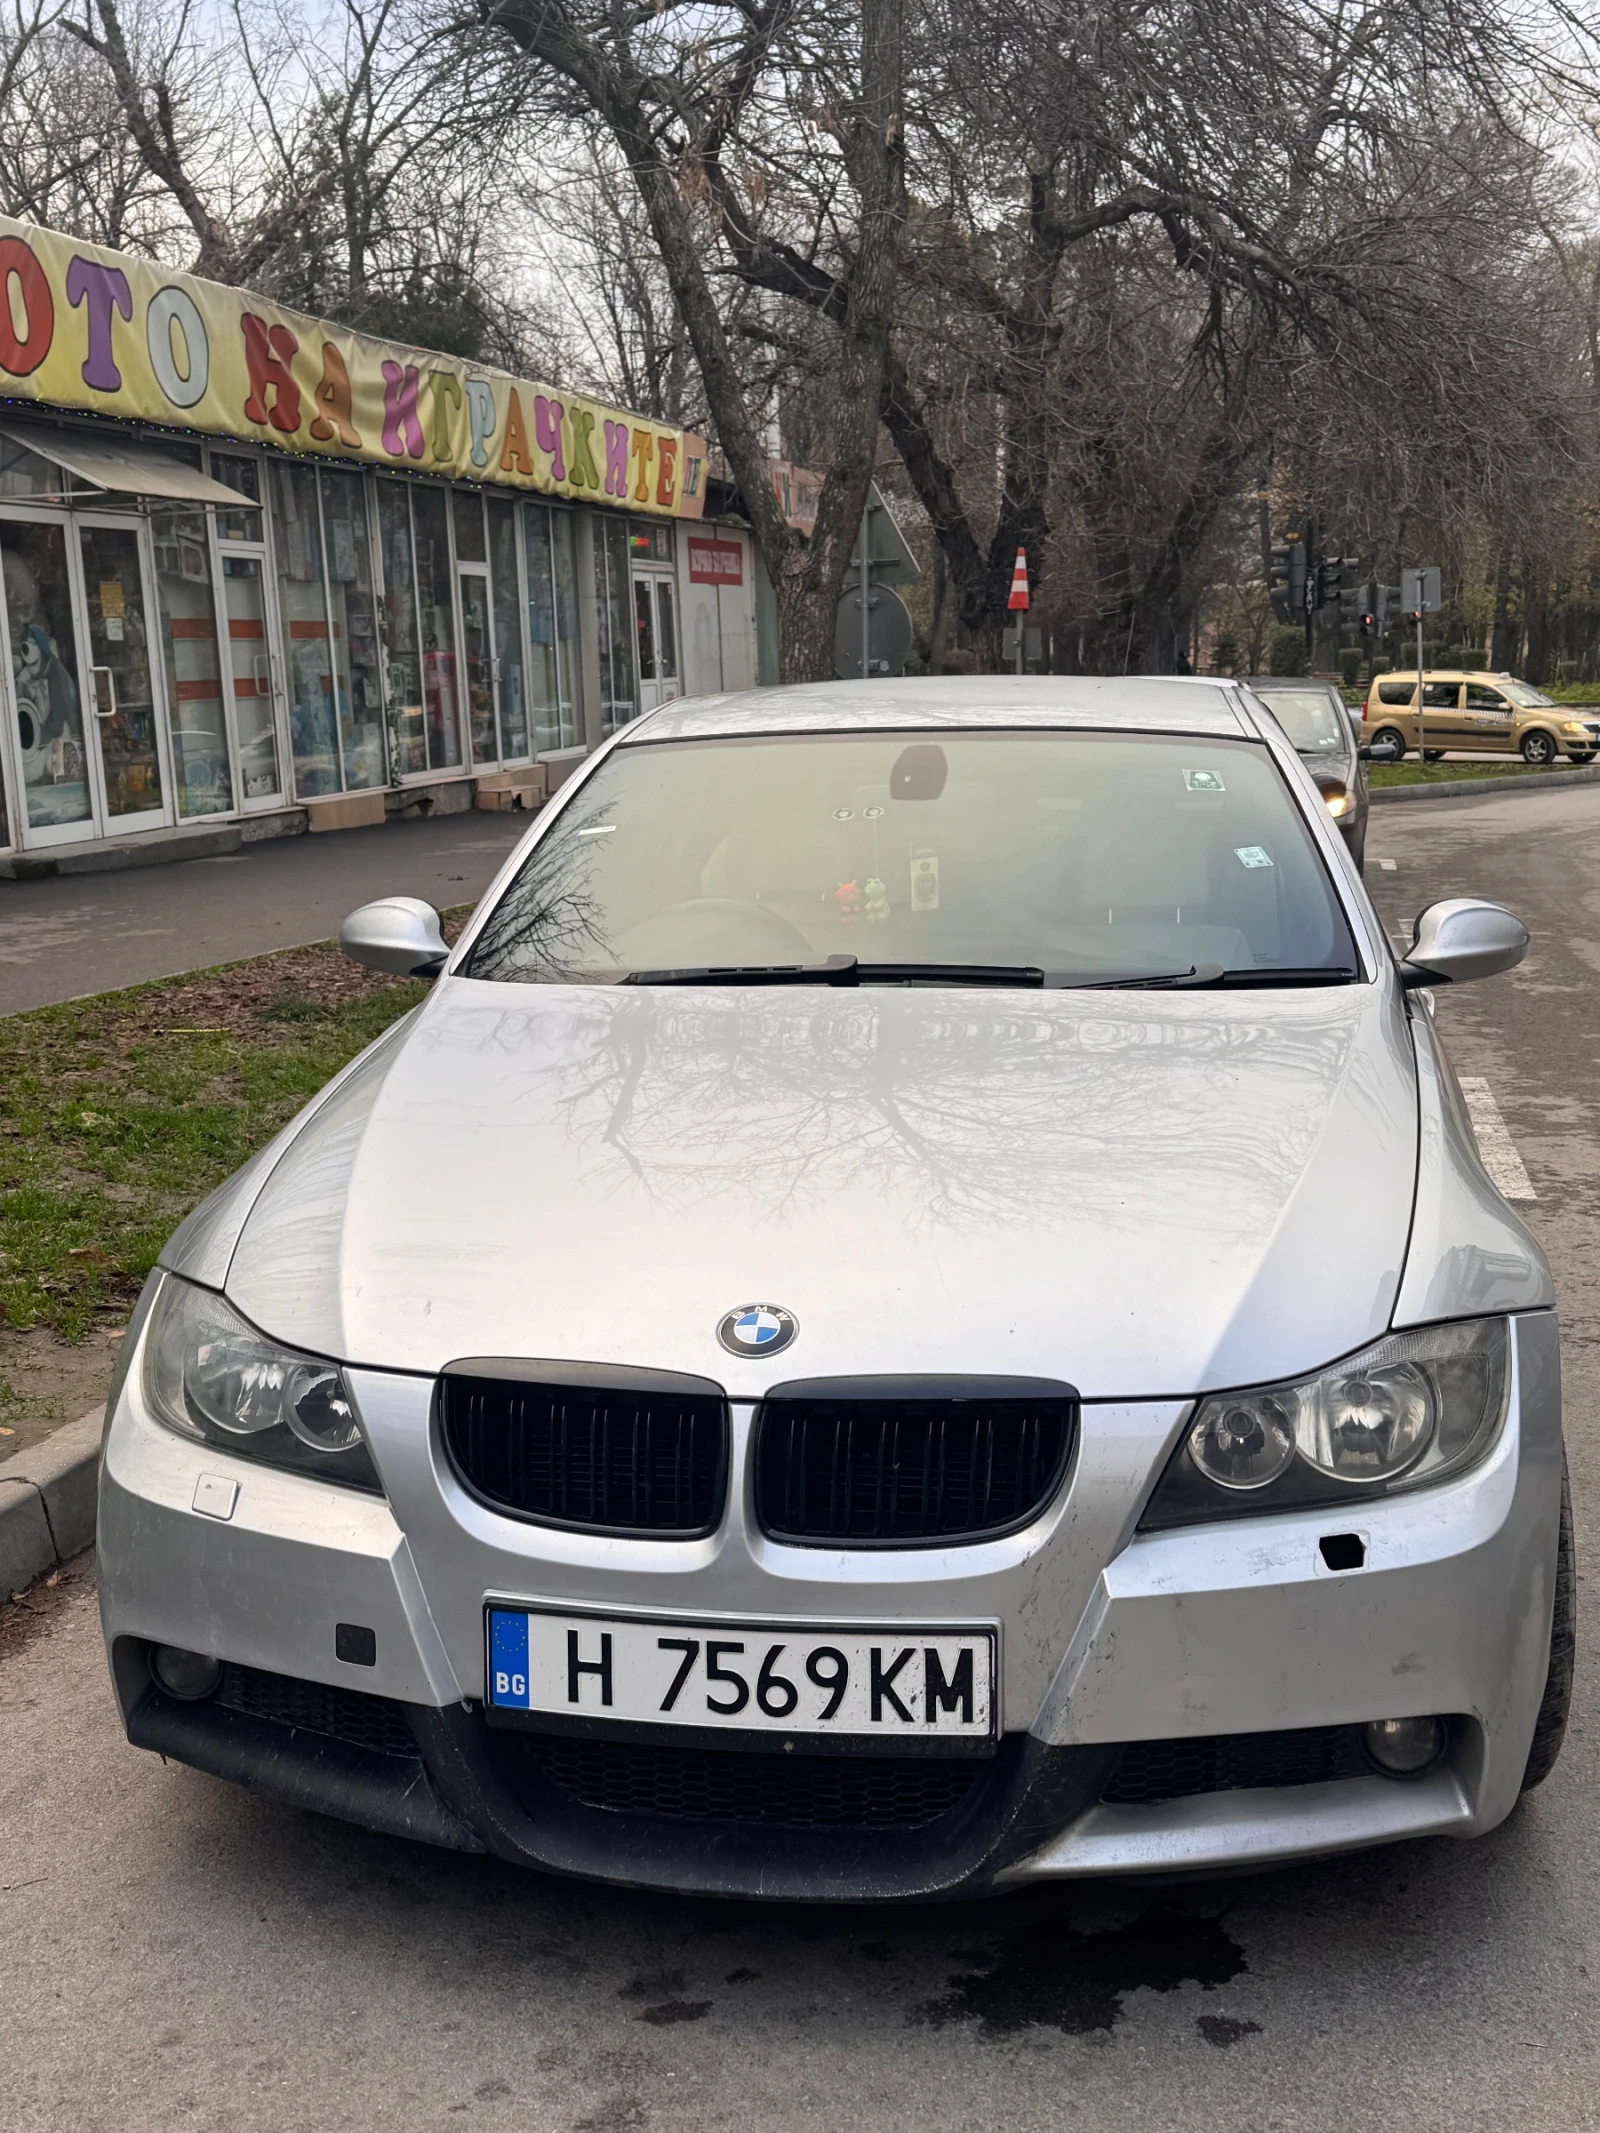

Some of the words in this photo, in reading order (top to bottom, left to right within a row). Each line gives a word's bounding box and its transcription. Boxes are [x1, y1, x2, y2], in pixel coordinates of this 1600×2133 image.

[240, 312, 362, 449] НА
[380, 360, 677, 506] ИГРАЧКИТЕ
[730, 1306, 791, 1321] BMW
[496, 1672, 526, 1696] BG
[567, 1630, 613, 1706] H
